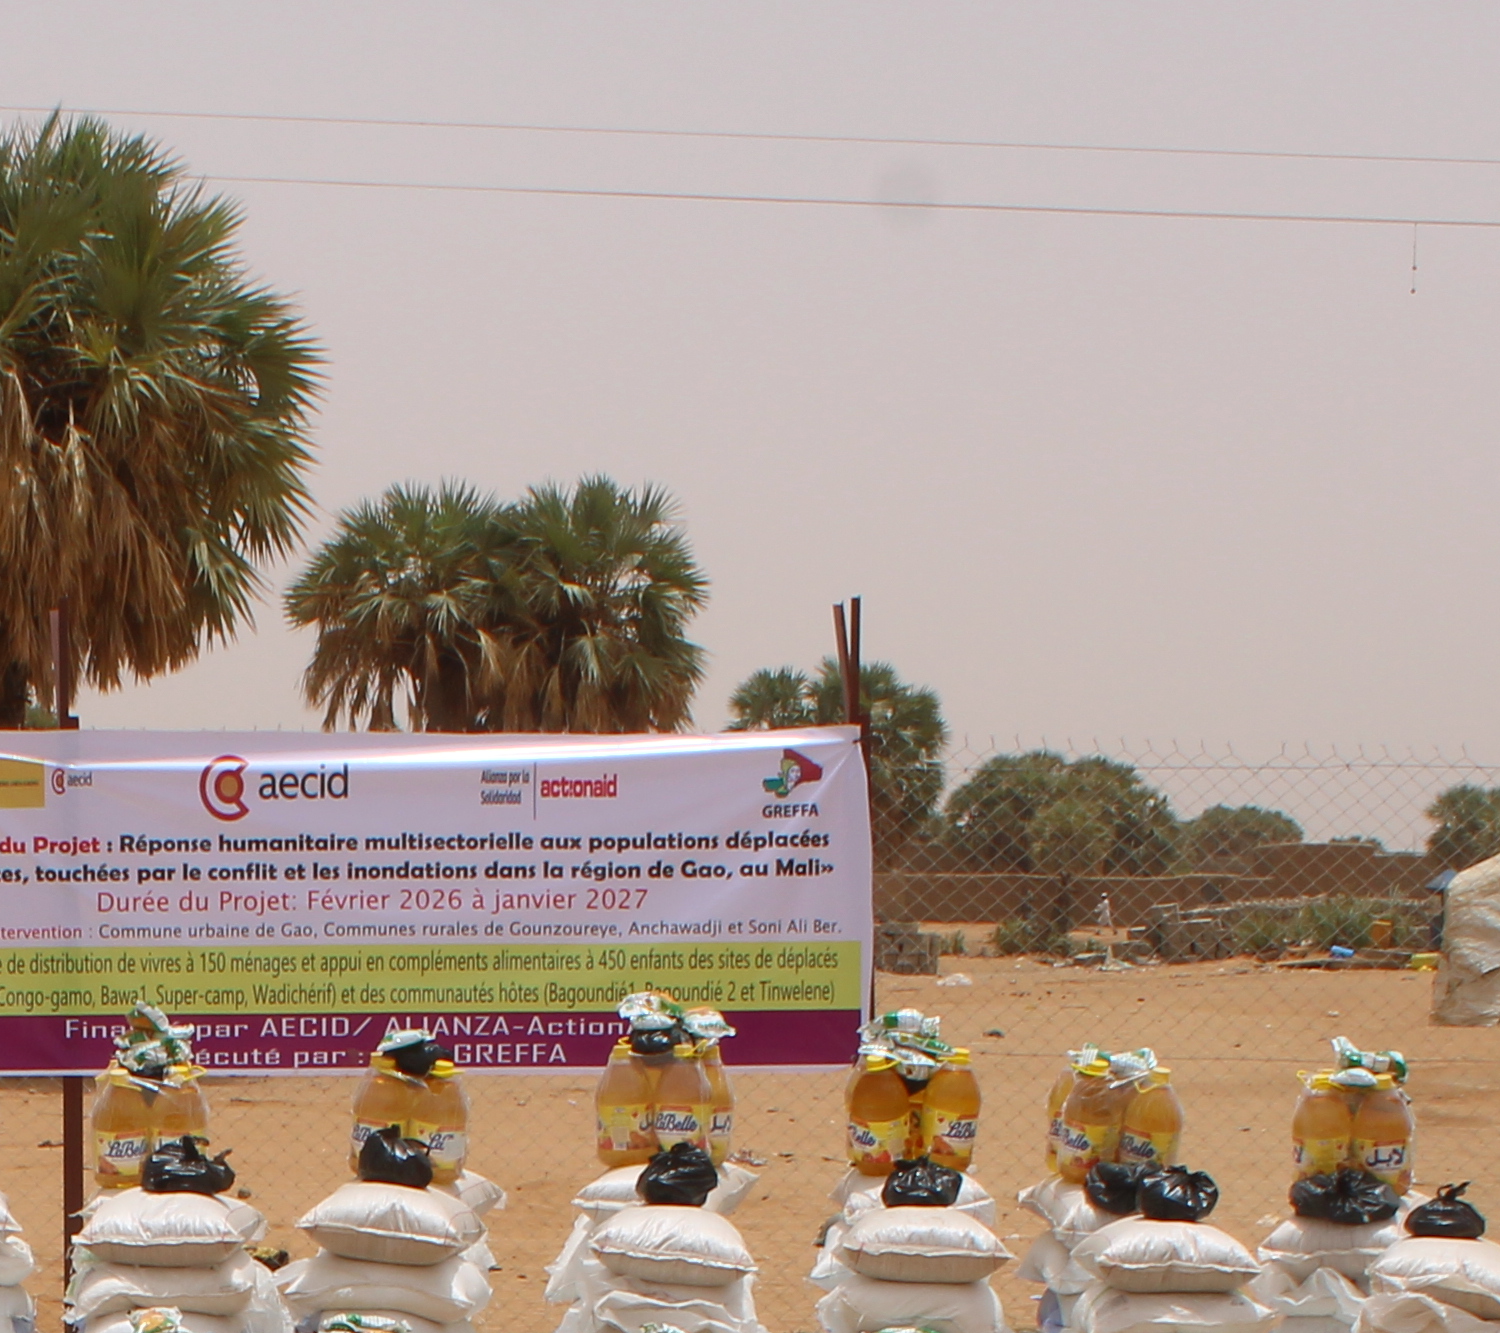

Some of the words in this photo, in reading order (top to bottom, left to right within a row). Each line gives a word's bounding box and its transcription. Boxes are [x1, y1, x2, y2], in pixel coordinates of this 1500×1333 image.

[258, 763, 349, 799] aecid
[762, 804, 818, 818] GREFFA
[33, 836, 100, 857] Projet
[119, 834, 211, 856] Réponse
[219, 834, 358, 852] humanitaire
[365, 831, 533, 851] multisectorielle
[540, 834, 582, 849] aux
[588, 832, 719, 853] populations
[726, 829, 829, 851] déplacées
[35, 864, 130, 882] touchées
[136, 866, 176, 884] par
[183, 864, 201, 881] le
[207, 862, 277, 881] conflit
[284, 864, 306, 880] et
[313, 862, 340, 880] les
[347, 861, 477, 880] inondations
[484, 860, 536, 879] dans
[543, 861, 563, 878] la
[571, 861, 641, 881] région
[648, 861, 674, 879] de
[680, 860, 733, 880] Gao,
[740, 862, 768, 877] au
[97, 890, 170, 912] Durée
[179, 891, 210, 912] du
[219, 891, 297, 916] Projet:
[308, 889, 390, 910] Février
[400, 889, 462, 910] 2026
[472, 887, 485, 910] à
[492, 888, 577, 915] janvier
[586, 889, 648, 910] 2027
[99, 924, 182, 939] Commune
[188, 923, 249, 939] urbaine
[255, 922, 274, 937] de
[281, 923, 318, 939] Gao,
[324, 921, 415, 937] Communes
[422, 921, 478, 937] rurales
[484, 921, 503, 936] de
[510, 921, 622, 938] Gounzoureye,
[628, 920, 722, 937] Anchawadji
[728, 921, 742, 934] et
[749, 920, 782, 934] Soni
[787, 920, 807, 934] Ali
[813, 920, 842, 934] Ber.
[7, 953, 24, 974] de
[29, 952, 112, 974] distribution
[117, 952, 135, 973] de
[140, 952, 181, 973] vivres
[186, 952, 194, 972] à
[201, 952, 226, 973] 150
[230, 950, 297, 978] ménages
[301, 954, 315, 972] et
[320, 950, 361, 977] appui
[366, 956, 384, 972] en
[389, 950, 488, 977] compléments
[493, 949, 582, 970] alimentaires
[586, 950, 594, 970] à
[598, 951, 625, 970] 450
[630, 948, 684, 970] enfants
[689, 948, 713, 970] des
[718, 948, 750, 969] sites
[755, 948, 773, 969] de
[777, 947, 838, 973] déplacés
[156, 984, 248, 1010] Super-camp,
[253, 983, 336, 1008] Wadichérif)
[341, 985, 355, 1004] et
[360, 983, 385, 1004] des
[390, 982, 493, 1003] communautés
[499, 981, 538, 1002] hôtes
[727, 981, 736, 1000] 2
[741, 982, 755, 1000] et
[760, 980, 834, 1004] Tinwelene)
[196, 1023, 248, 1042] par
[260, 1016, 373, 1037] AECID/
[195, 1048, 280, 1066] écuté
[294, 1051, 346, 1068] par
[454, 1043, 566, 1063] GREFFA
